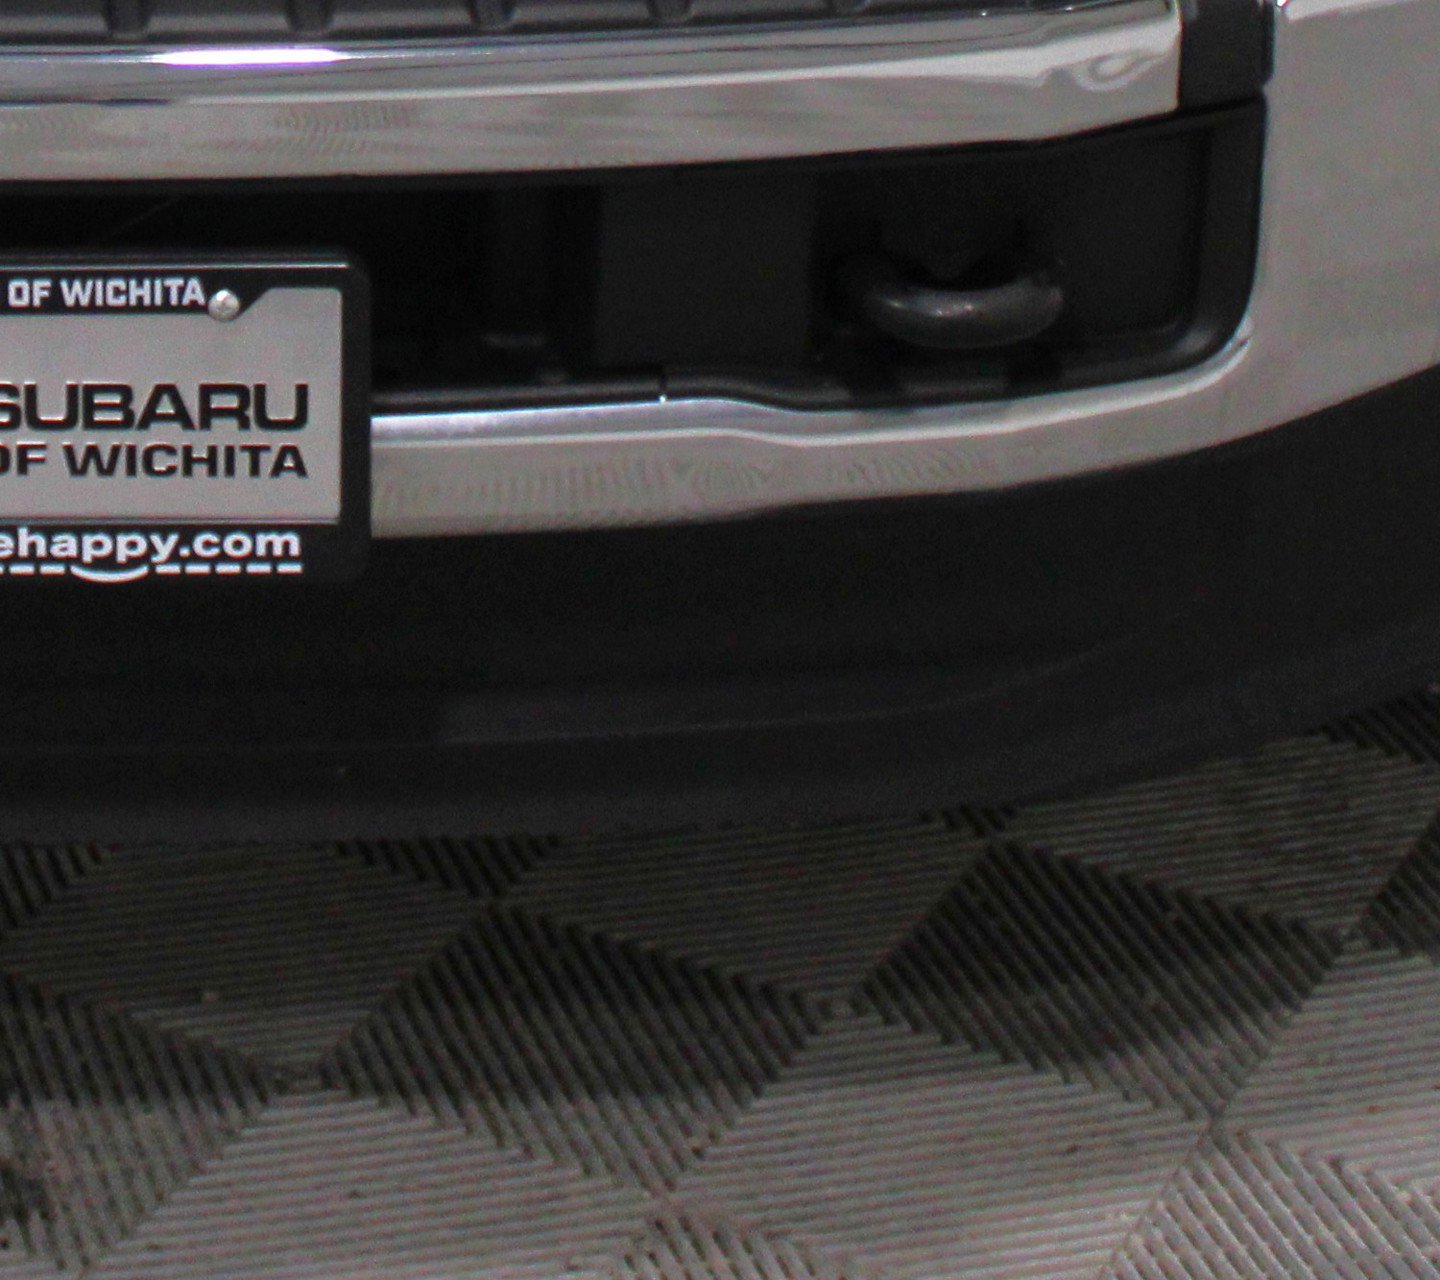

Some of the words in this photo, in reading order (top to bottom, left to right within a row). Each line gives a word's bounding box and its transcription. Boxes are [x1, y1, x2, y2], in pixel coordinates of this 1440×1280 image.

[8, 279, 51, 307] OF
[60, 277, 206, 307] WICHITA
[62, 443, 308, 478] WICHITA
